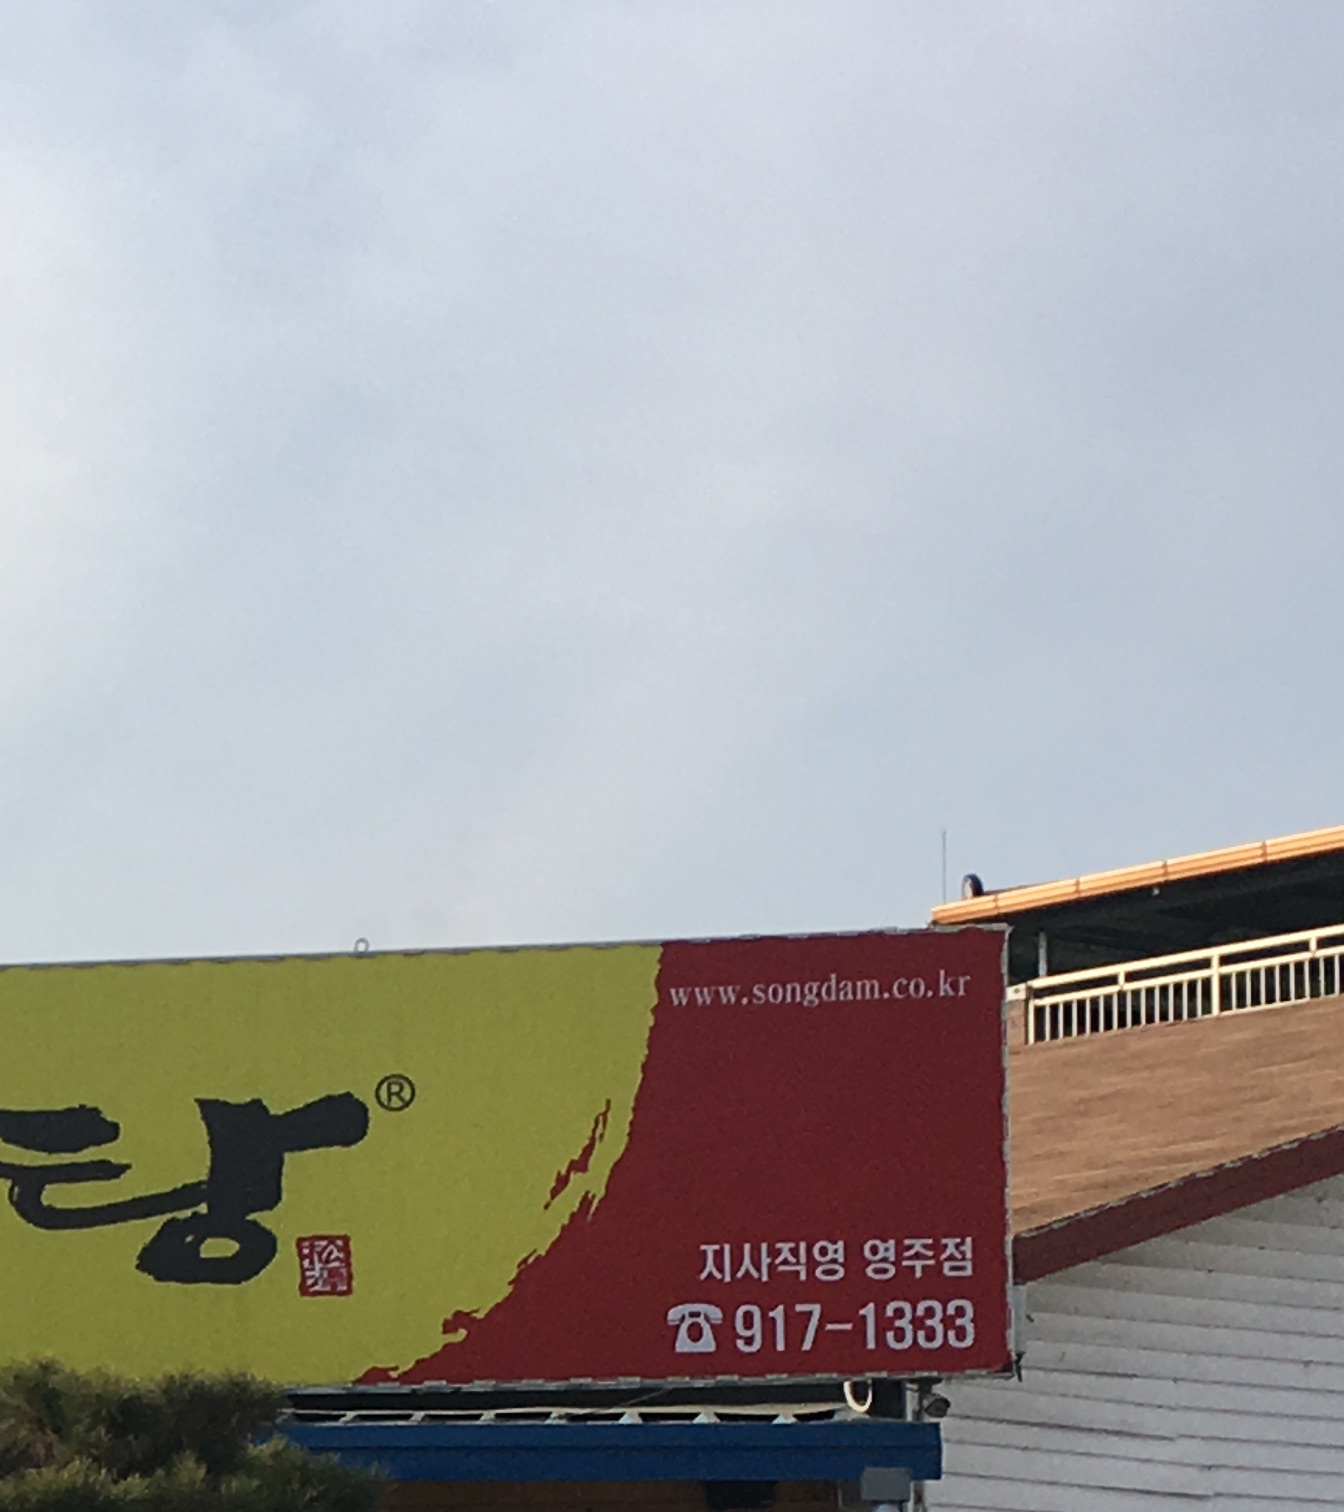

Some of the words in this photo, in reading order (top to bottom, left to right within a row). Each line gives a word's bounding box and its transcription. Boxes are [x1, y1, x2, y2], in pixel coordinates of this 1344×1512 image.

[669, 969, 971, 1007] www.songdam.co.kr
[699, 1239, 846, 1283] 지사직영
[863, 1236, 974, 1279] 영주점
[734, 1299, 975, 1352] 917-1333
